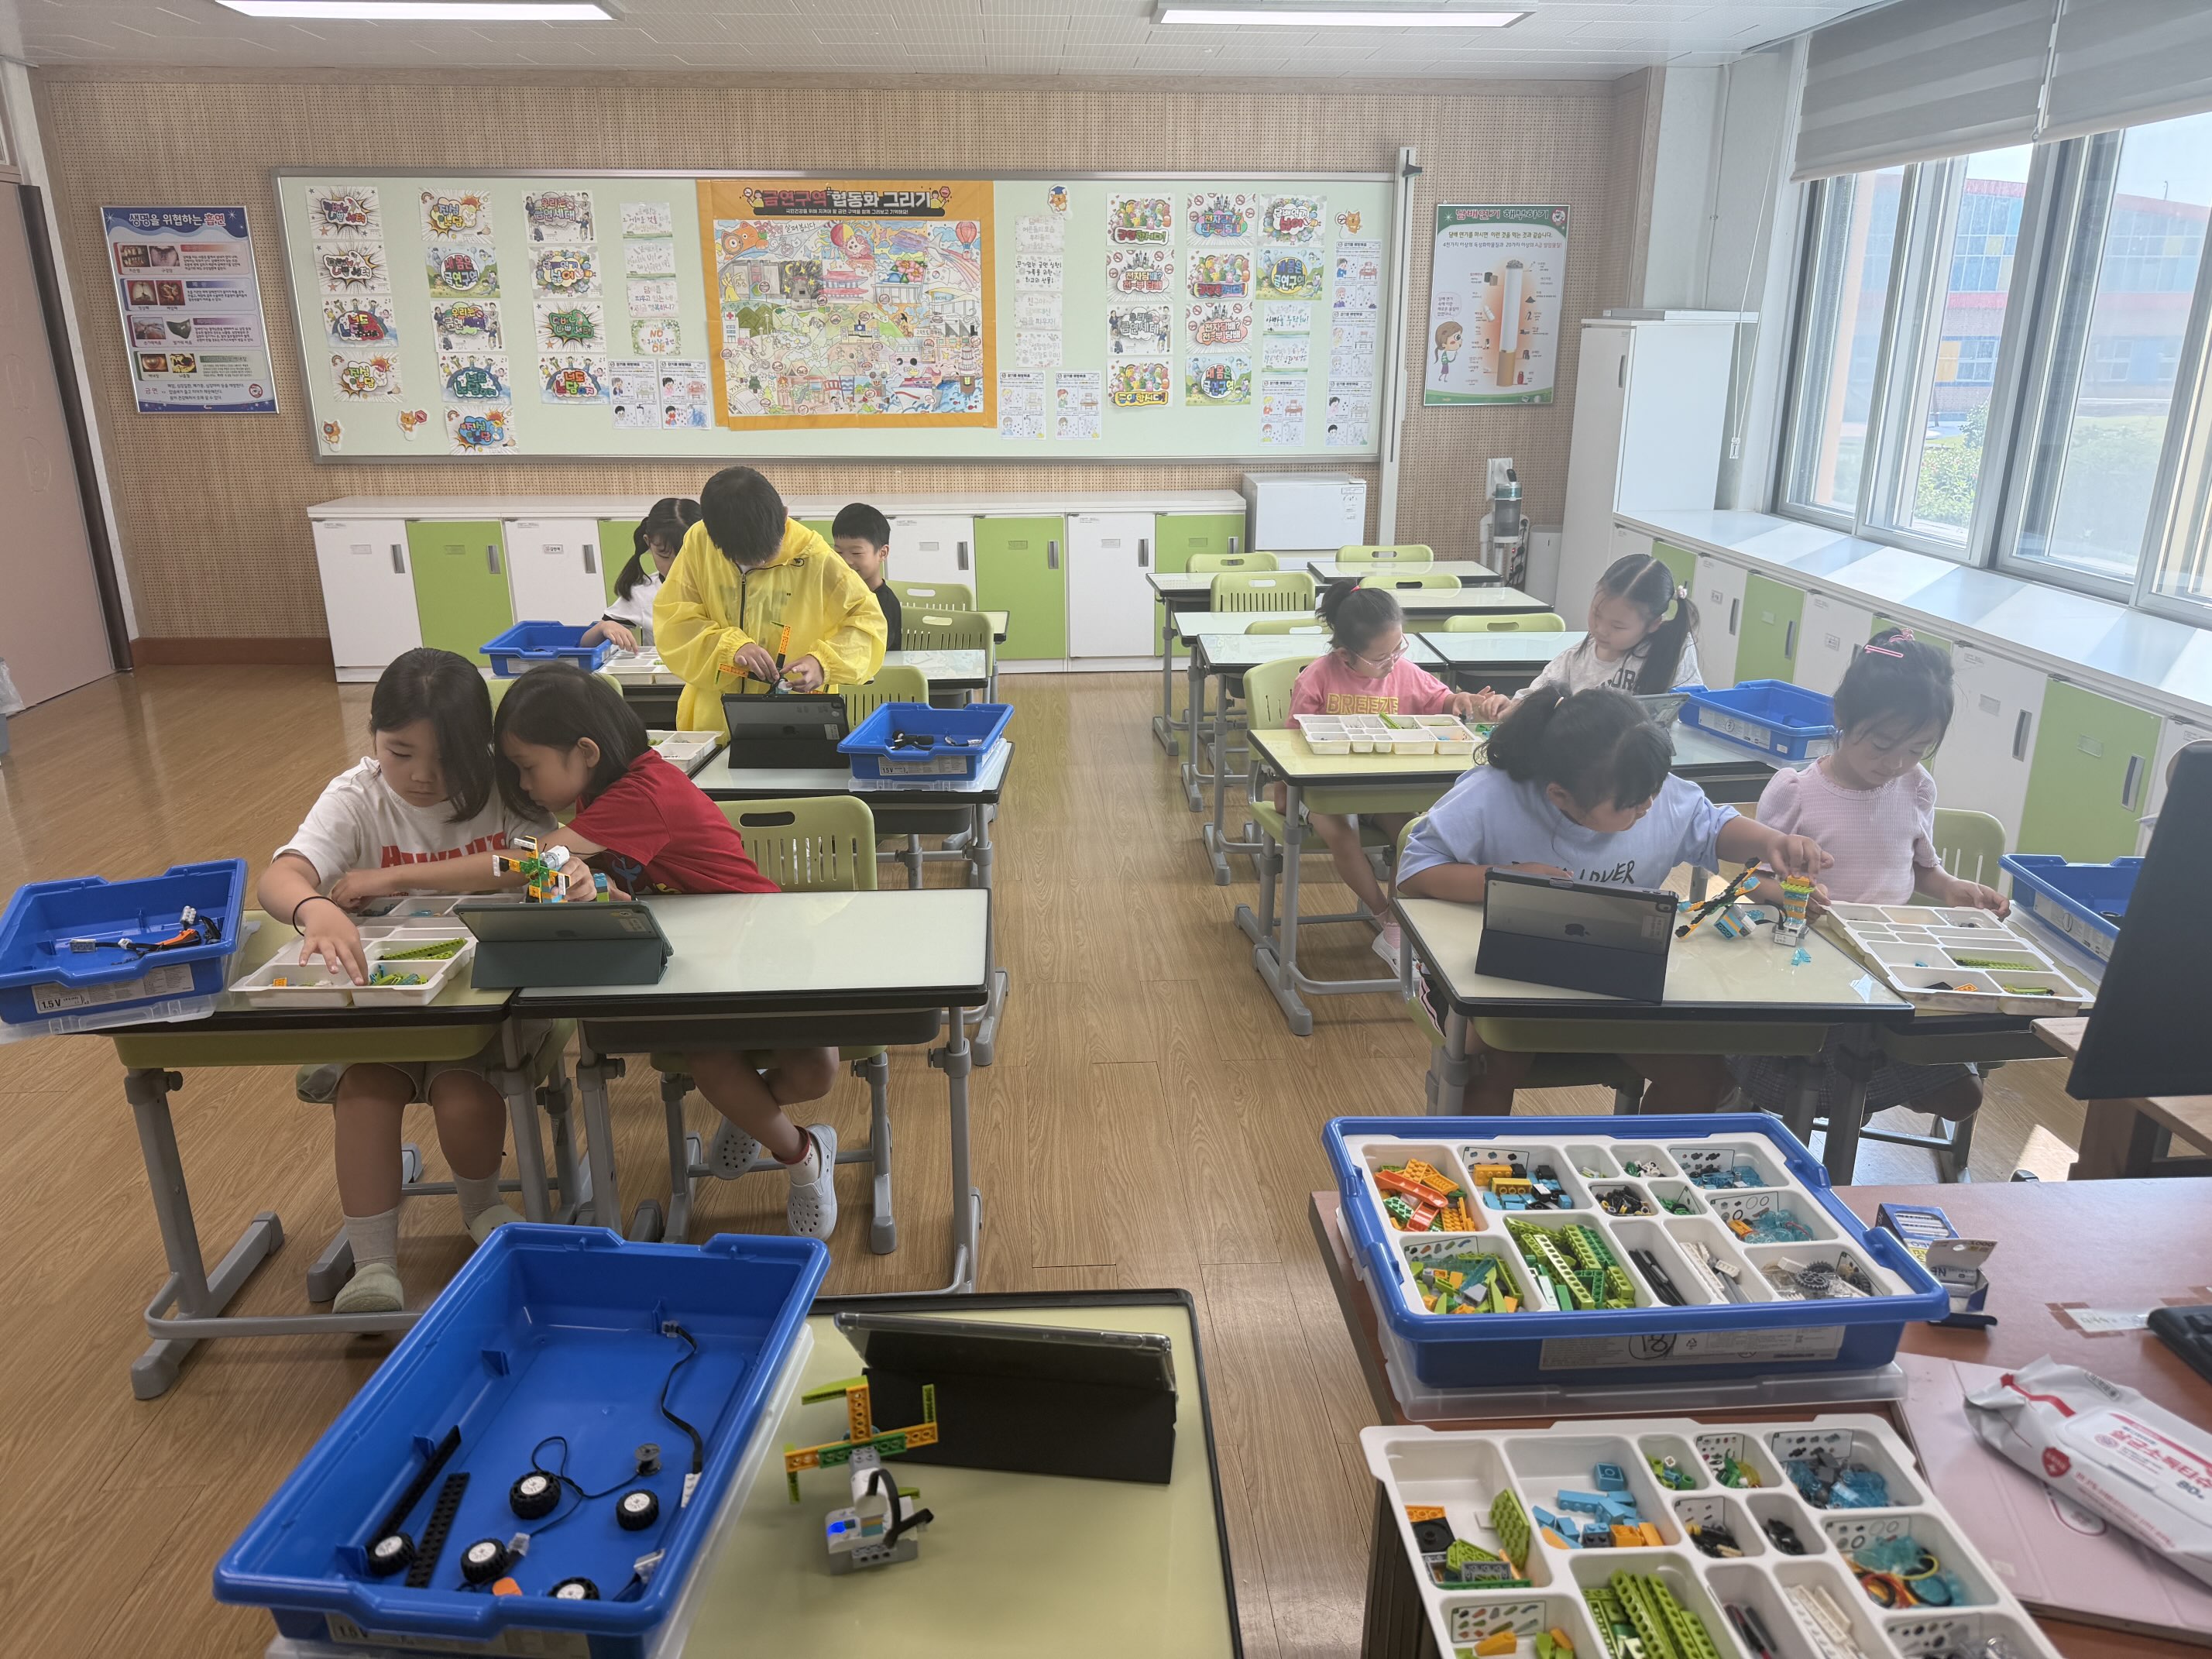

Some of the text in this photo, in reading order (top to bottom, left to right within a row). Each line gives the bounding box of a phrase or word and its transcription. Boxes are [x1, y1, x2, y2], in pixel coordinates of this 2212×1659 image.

[763, 190, 929, 208] 금연구역 협동화 그리기
[534, 207, 575, 222] 금연세대
[1274, 208, 1308, 217] 담배연기
[1455, 209, 1549, 220] 담배연기 해부하기
[129, 212, 225, 226] 생명을 위협하는 흡연
[444, 270, 478, 287] 금연구역
[551, 270, 575, 283] 싫어
[1125, 272, 1163, 280] 전자담배?
[1274, 274, 1305, 290] 금연구역
[452, 307, 476, 317] 우리는
[1129, 312, 1152, 323] 우리는
[1121, 321, 1159, 335] 금연세대
[1204, 321, 1240, 332] 전자담배?
[651, 329, 663, 338] NO
[349, 366, 370, 378] 진심
[465, 372, 486, 383] 너도
[563, 371, 585, 383] 너도
[1206, 365, 1231, 380] 내 몸은
[356, 376, 376, 388] 노담
[555, 380, 594, 395] 노담이지
[457, 381, 496, 396] 노담이지
[1203, 380, 1235, 397] 금연구역
[465, 421, 486, 431] 진심
[1326, 693, 1399, 714] BREEZE
[42, 998, 61, 1010] 1.5 V
